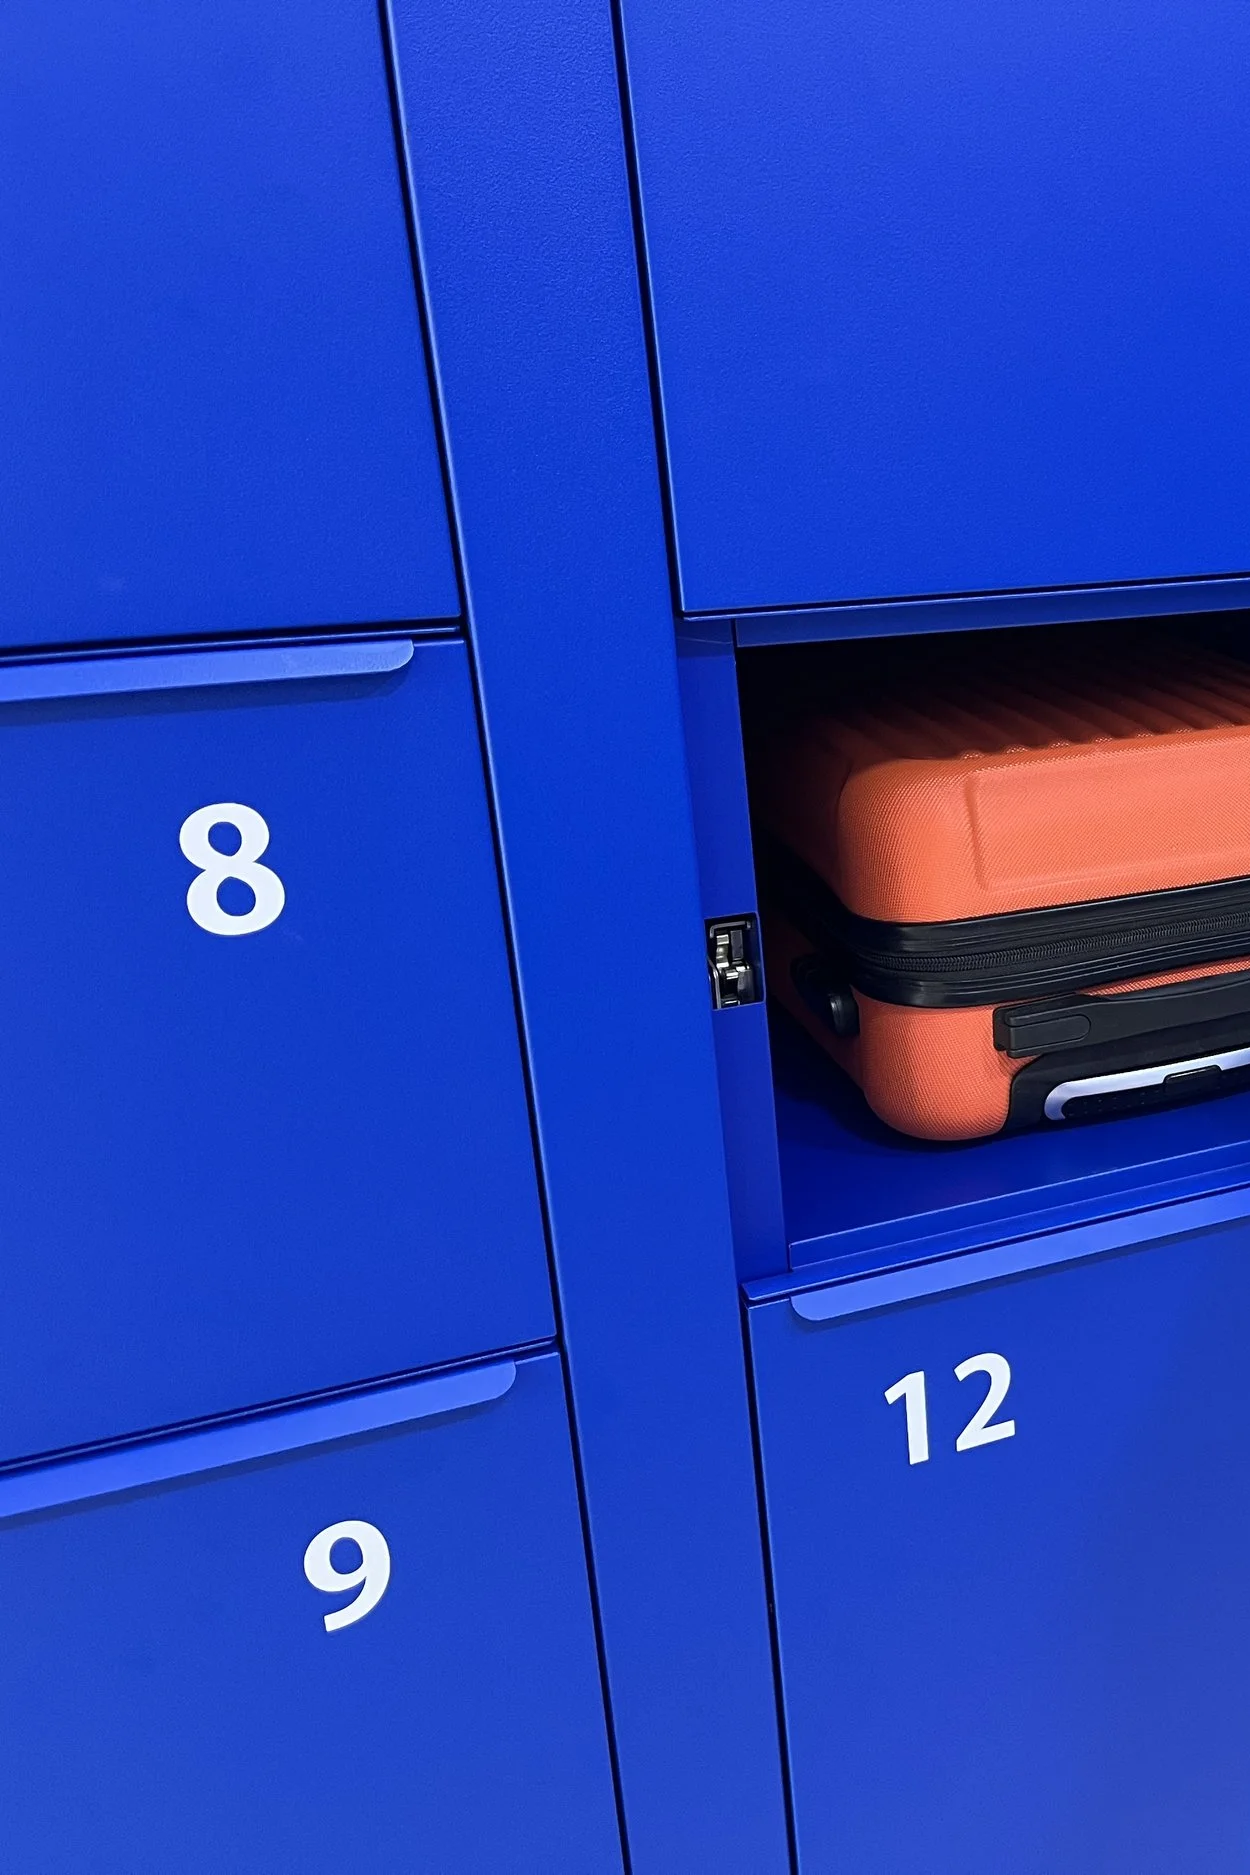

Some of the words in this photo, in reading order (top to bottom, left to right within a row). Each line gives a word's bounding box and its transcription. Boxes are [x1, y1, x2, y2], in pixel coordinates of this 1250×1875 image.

[178, 801, 286, 937] 8
[884, 1352, 1017, 1466] 12
[302, 1519, 392, 1633] 9
